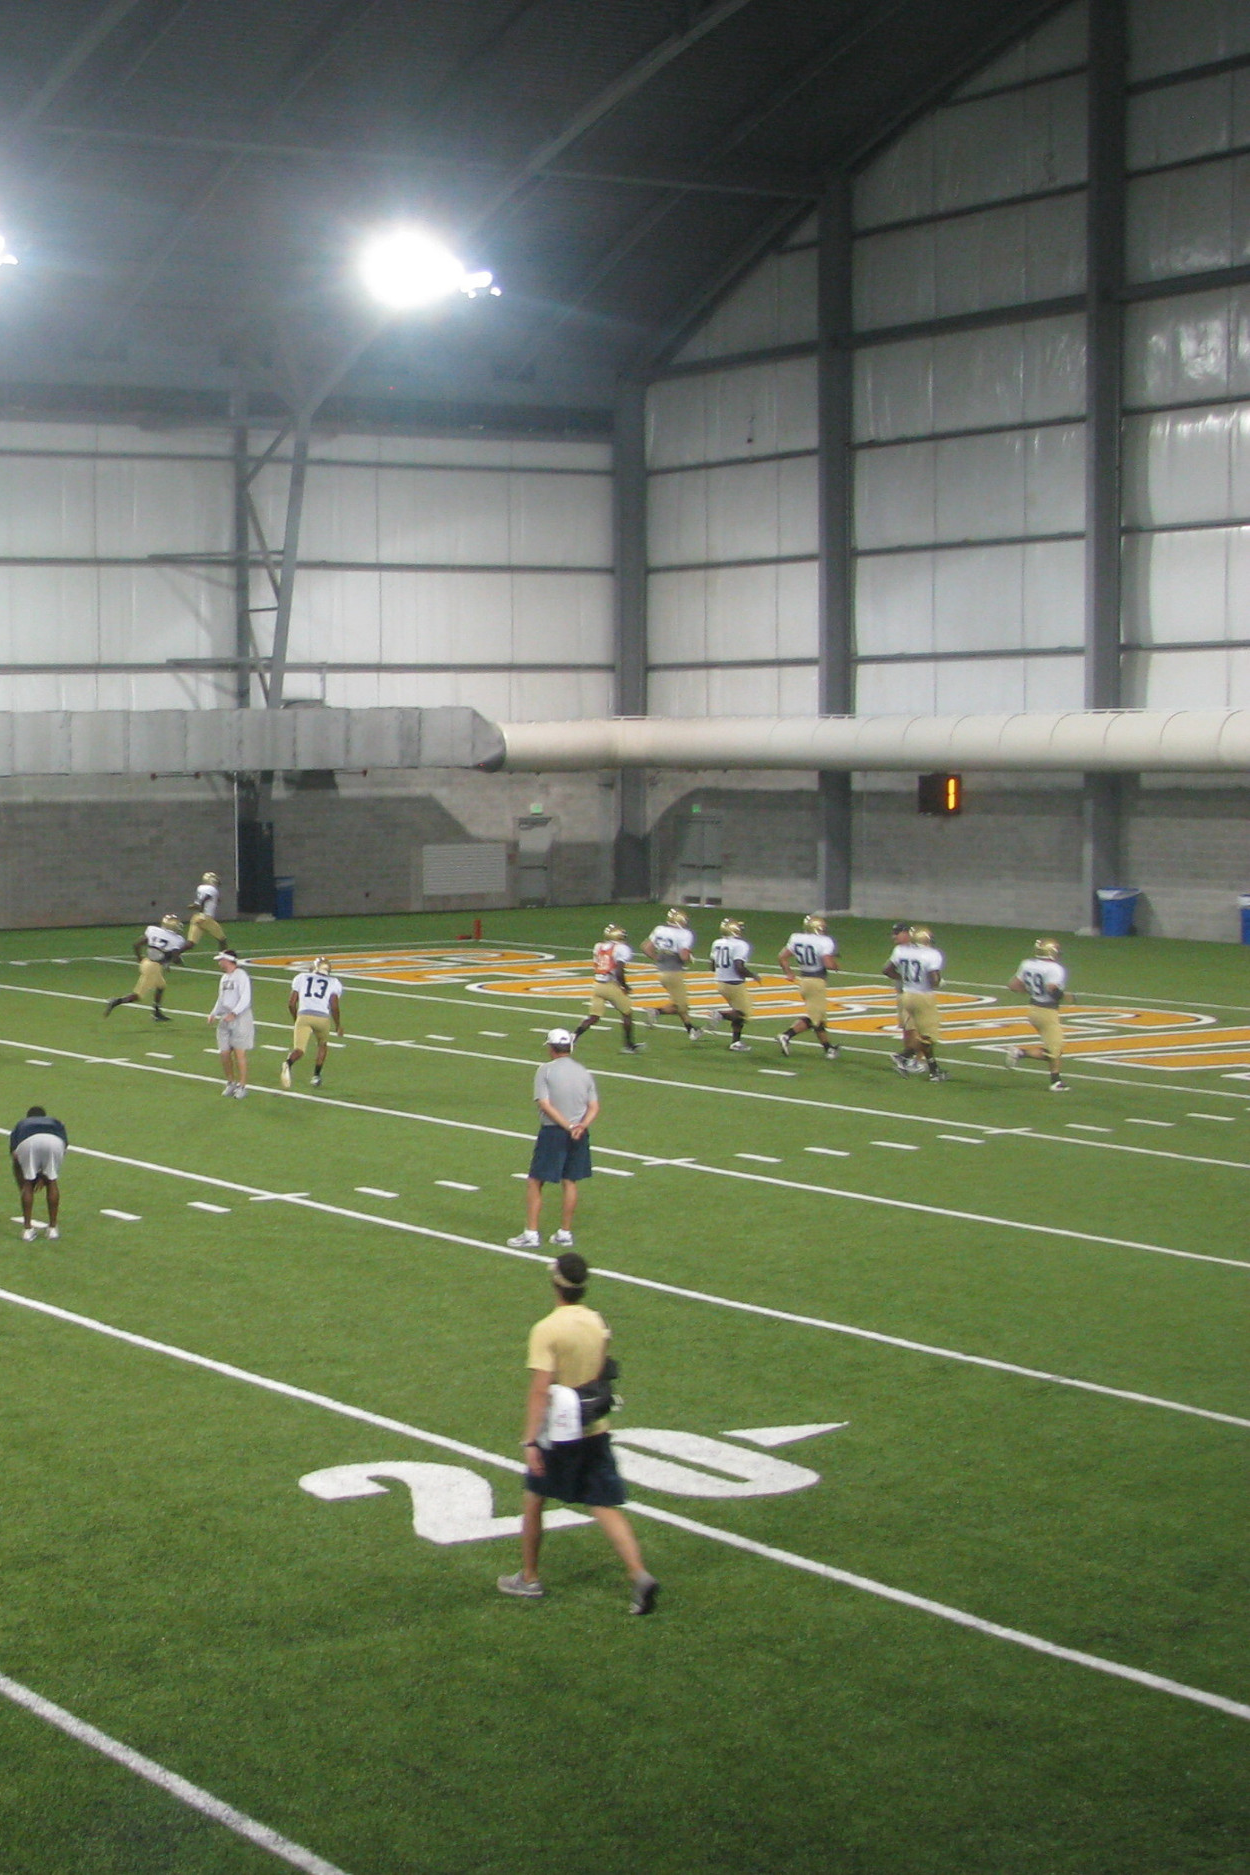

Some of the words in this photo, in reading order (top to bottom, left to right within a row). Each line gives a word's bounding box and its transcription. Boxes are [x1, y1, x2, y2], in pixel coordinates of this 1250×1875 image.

[947, 778, 956, 810] 1
[794, 943, 817, 967] 50
[304, 976, 329, 1000] 13
[236, 948, 1250, 1083] GEORGI
